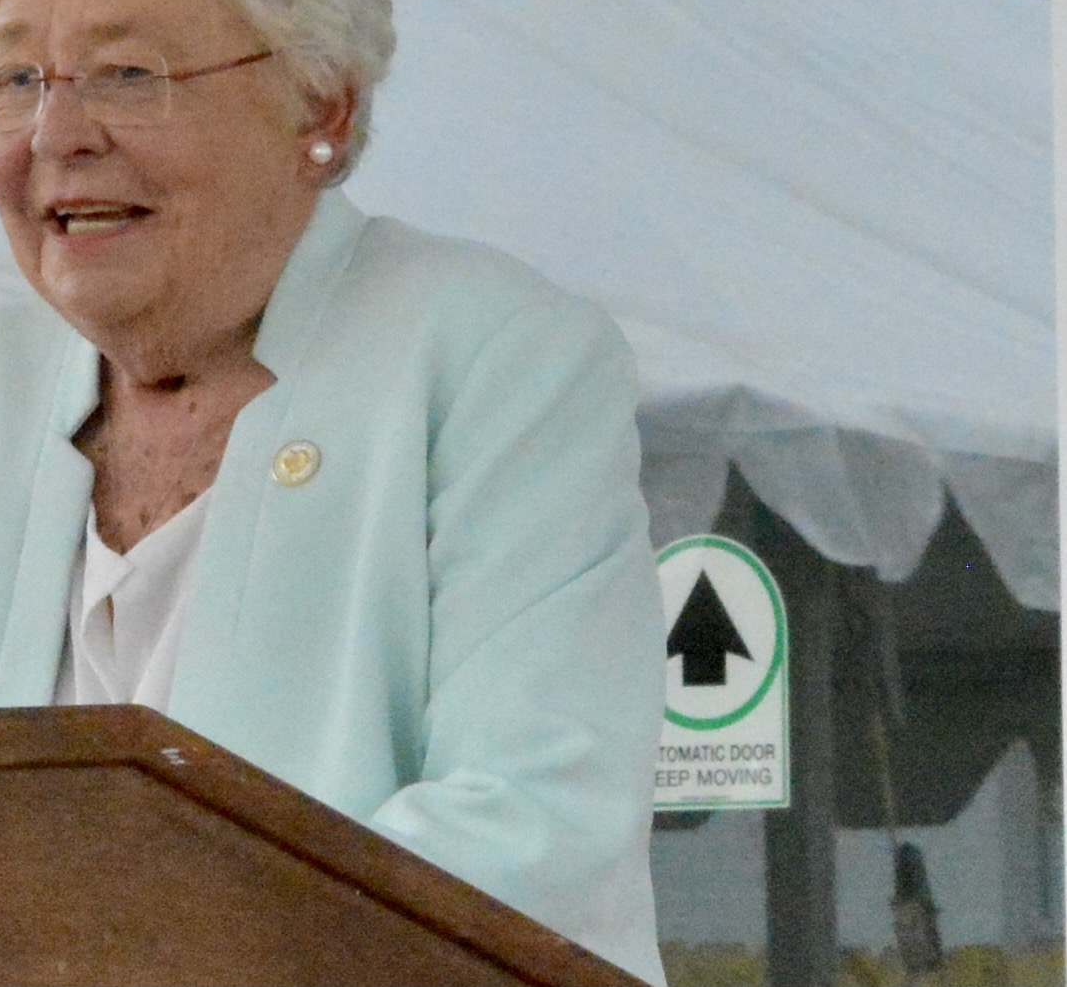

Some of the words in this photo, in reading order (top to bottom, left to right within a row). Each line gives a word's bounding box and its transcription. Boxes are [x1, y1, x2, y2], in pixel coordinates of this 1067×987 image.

[658, 745, 725, 762] TOMATIC
[730, 744, 775, 761] DOOR
[655, 770, 690, 787] EEP
[697, 768, 772, 786] MOVING
